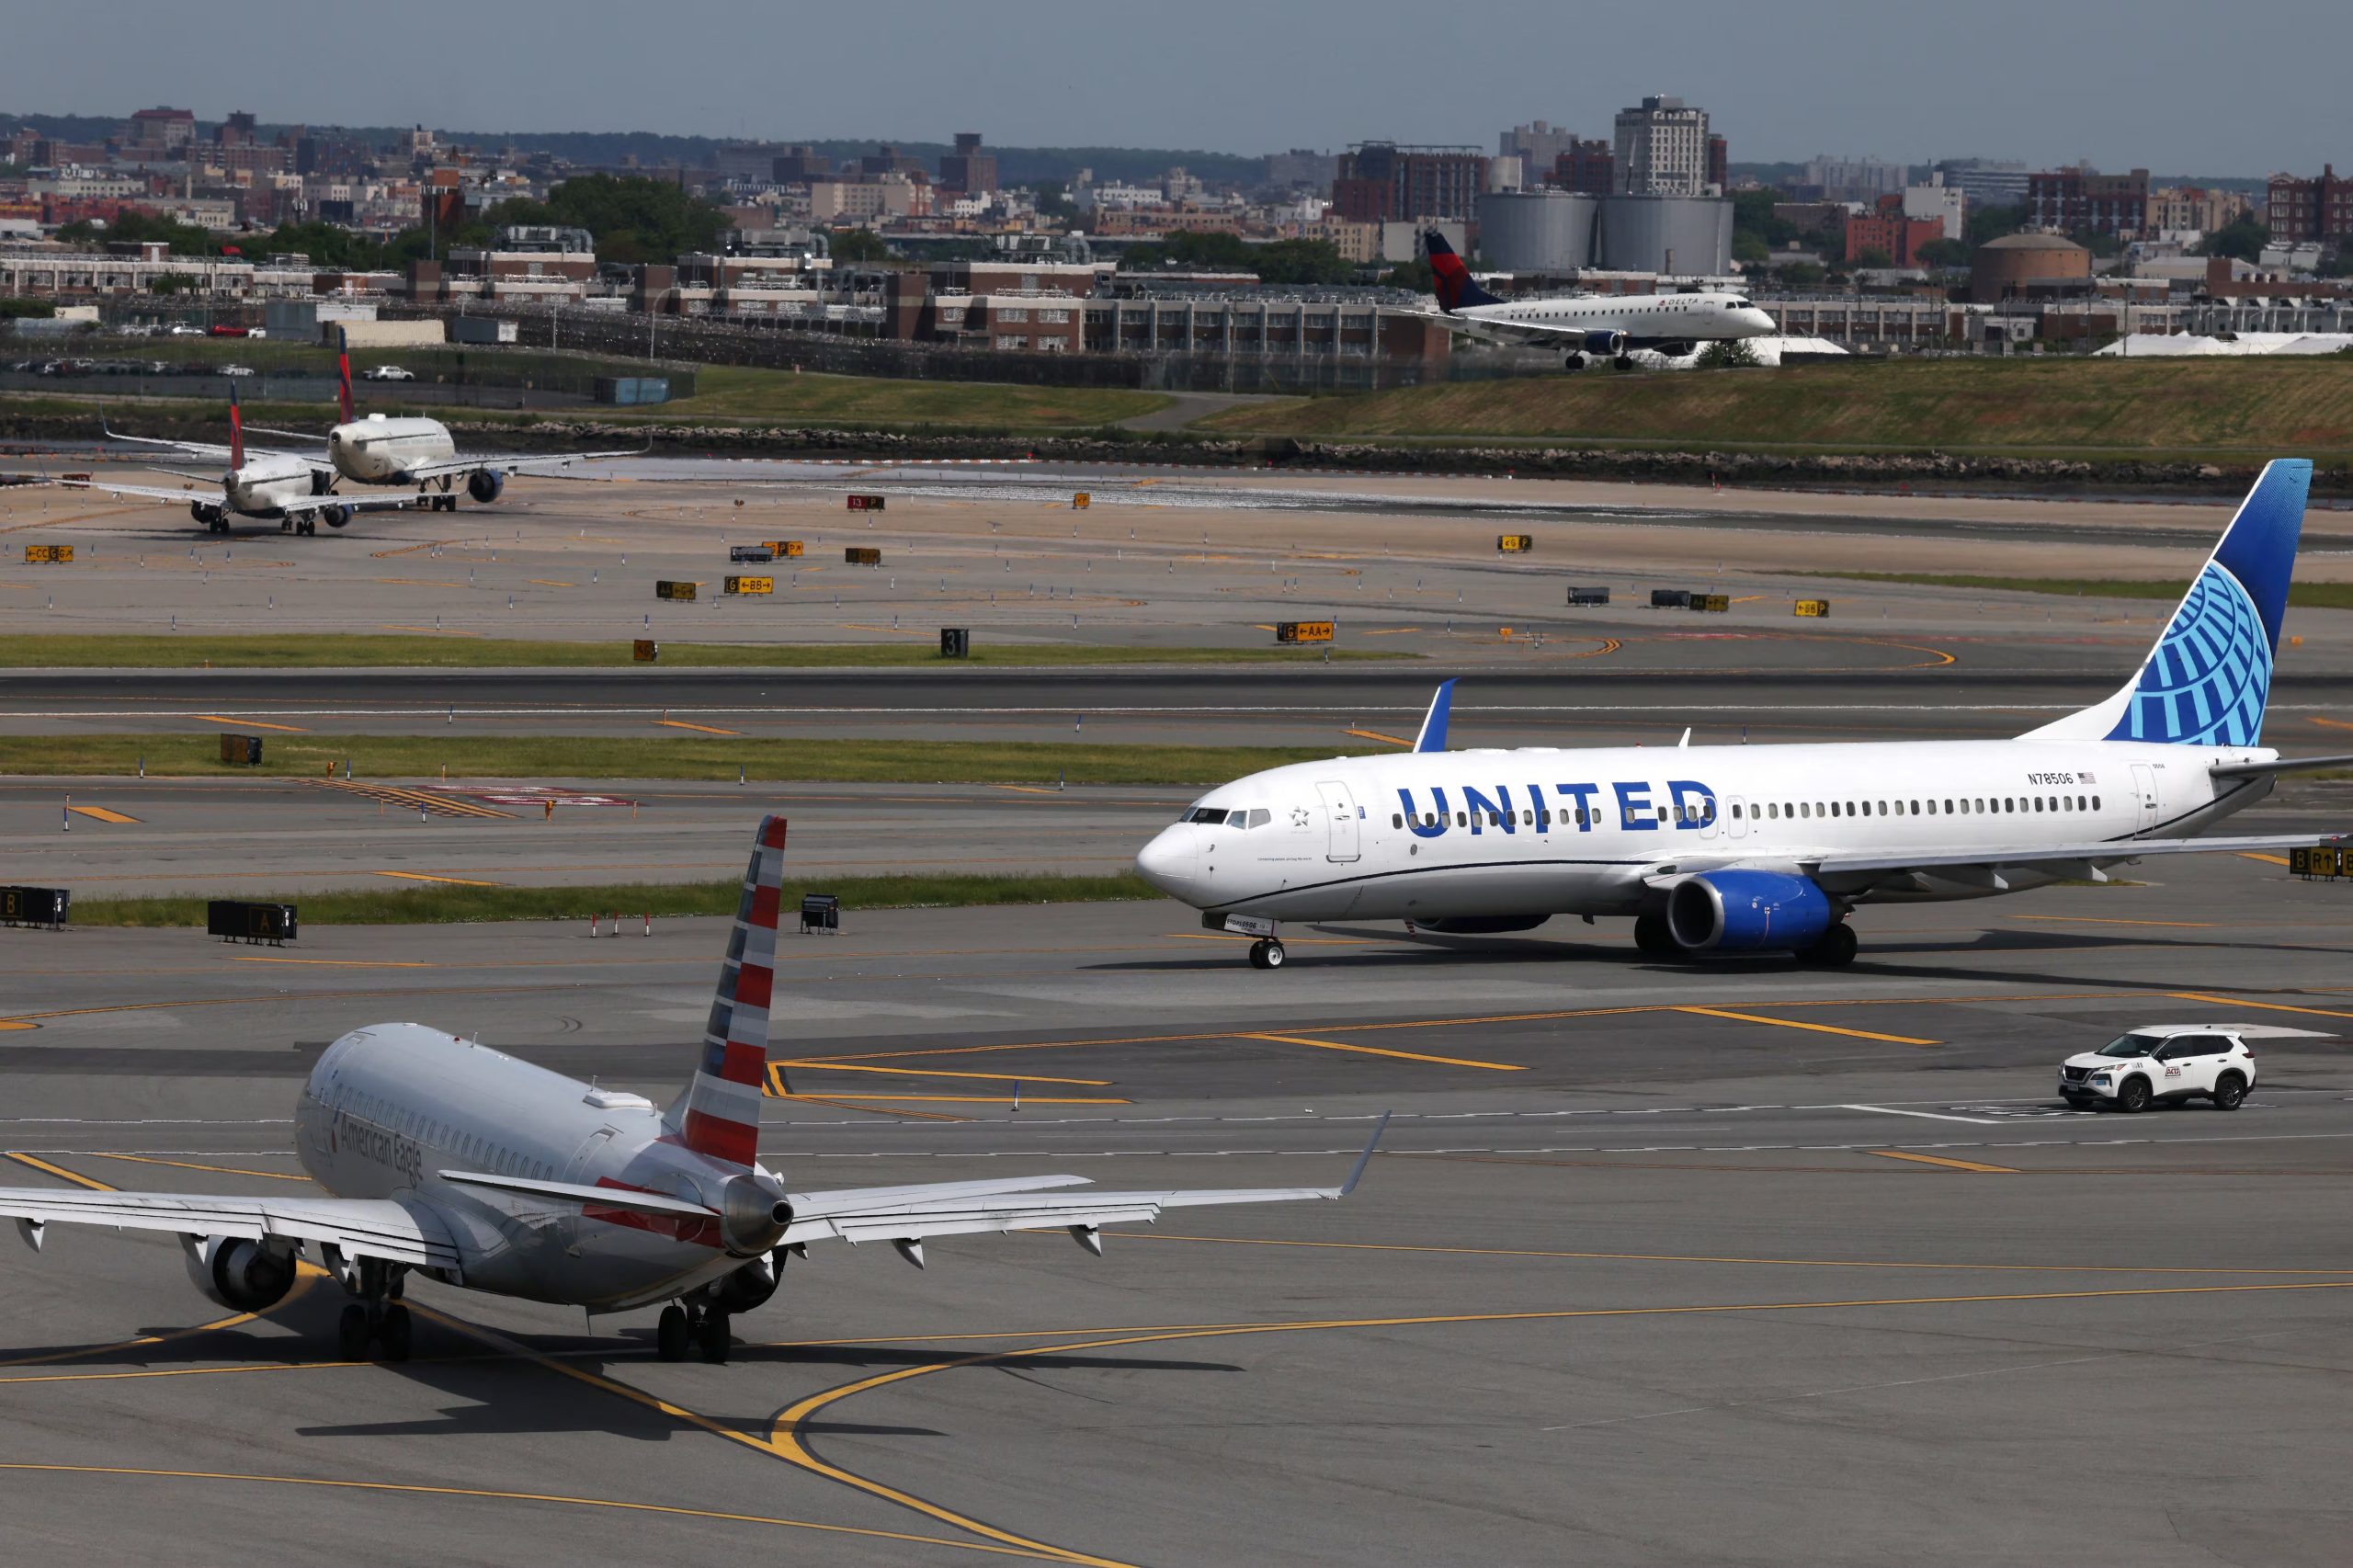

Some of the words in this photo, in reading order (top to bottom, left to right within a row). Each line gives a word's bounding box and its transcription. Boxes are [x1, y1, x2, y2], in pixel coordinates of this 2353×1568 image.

[853, 498, 862, 507] 13
[37, 549, 48, 558] CC
[51, 549, 58, 559] G
[730, 580, 736, 590] G
[750, 580, 763, 590] BB
[1288, 627, 1294, 638] G
[1309, 625, 1322, 637] AA
[947, 631, 956, 655] 3
[2027, 772, 2074, 785] N78506
[1396, 780, 1717, 838] UNITED
[2297, 851, 2305, 869] B
[2313, 852, 2322, 869] R
[6, 893, 16, 914] B
[259, 912, 271, 932] A
[341, 1111, 392, 1168] American
[393, 1133, 424, 1190] Eagle
